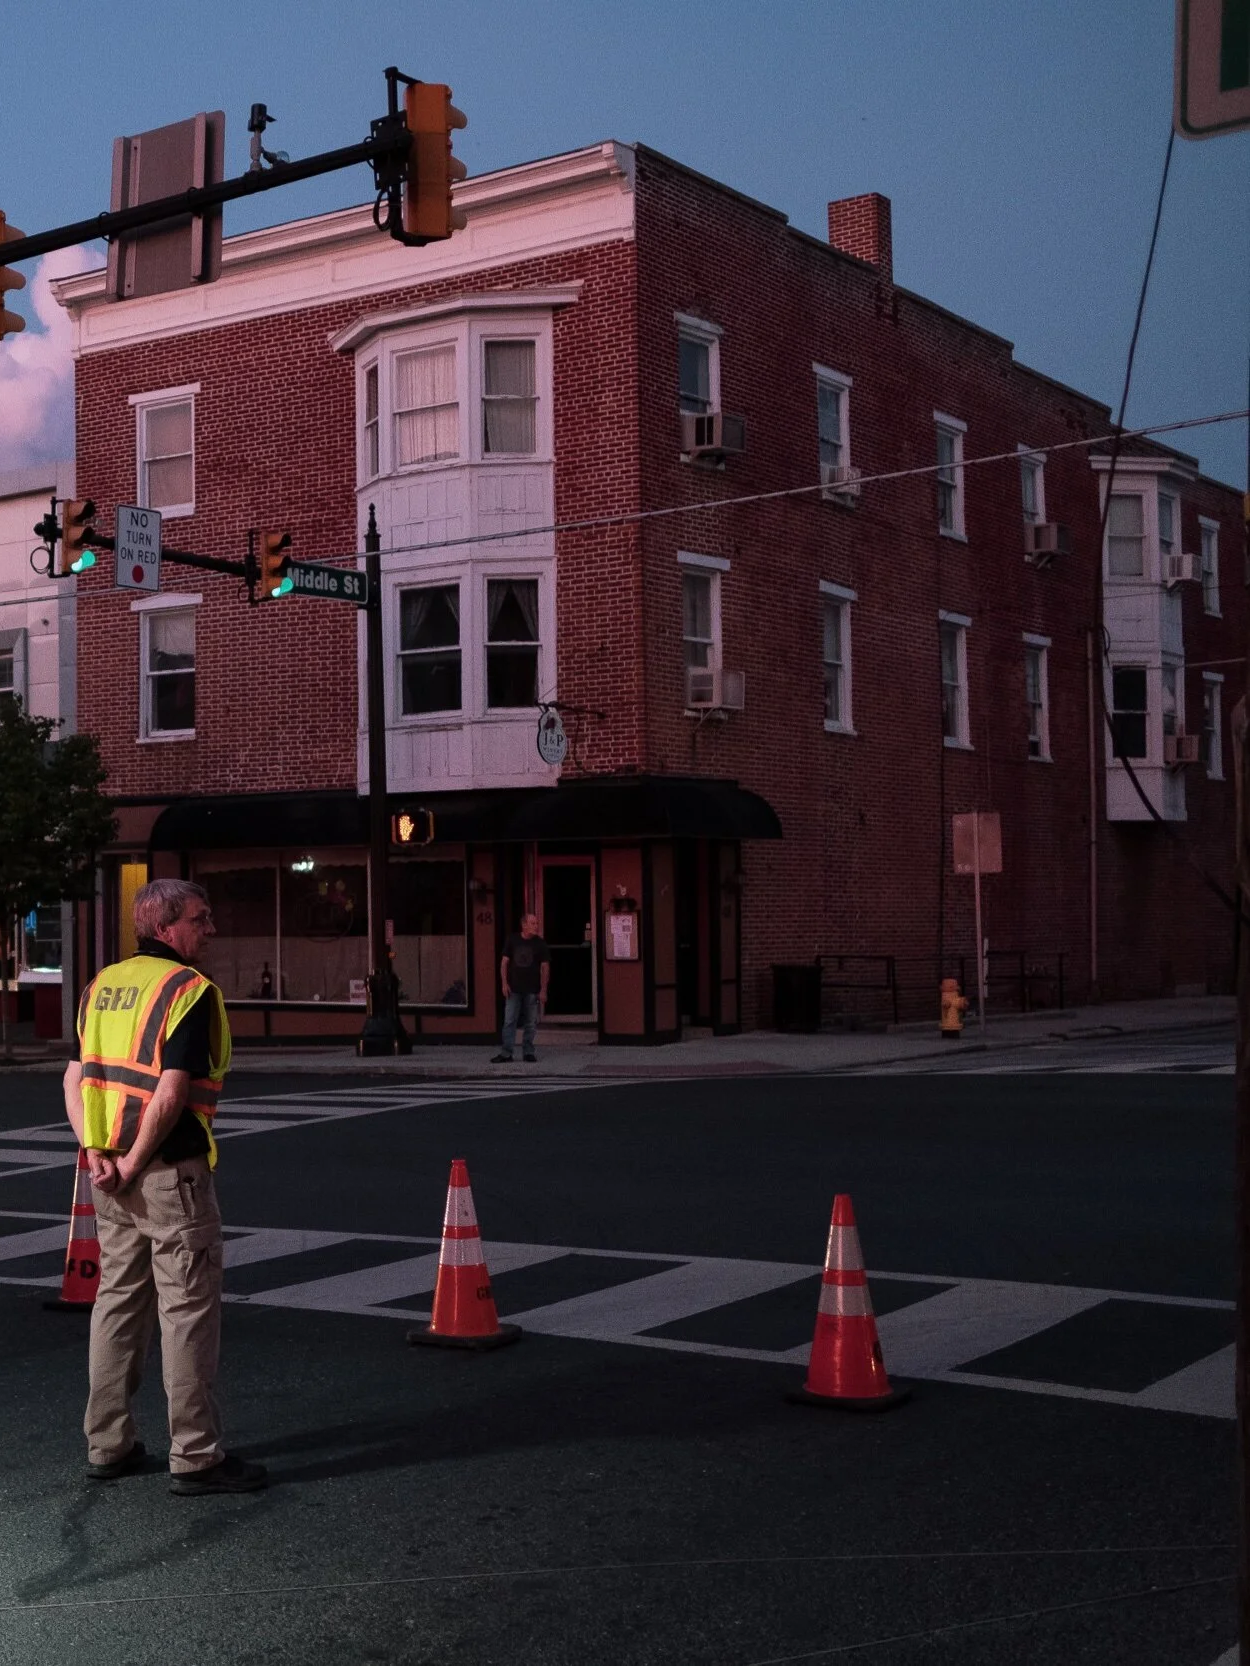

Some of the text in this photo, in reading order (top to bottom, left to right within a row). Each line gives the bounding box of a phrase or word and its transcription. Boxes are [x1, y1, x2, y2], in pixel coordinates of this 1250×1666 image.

[130, 511, 148, 528] NO
[126, 530, 152, 547] TURN
[120, 546, 157, 565] ON RED
[286, 567, 360, 595] Middle St
[476, 911, 492, 925] 48
[94, 986, 140, 1012] GFD
